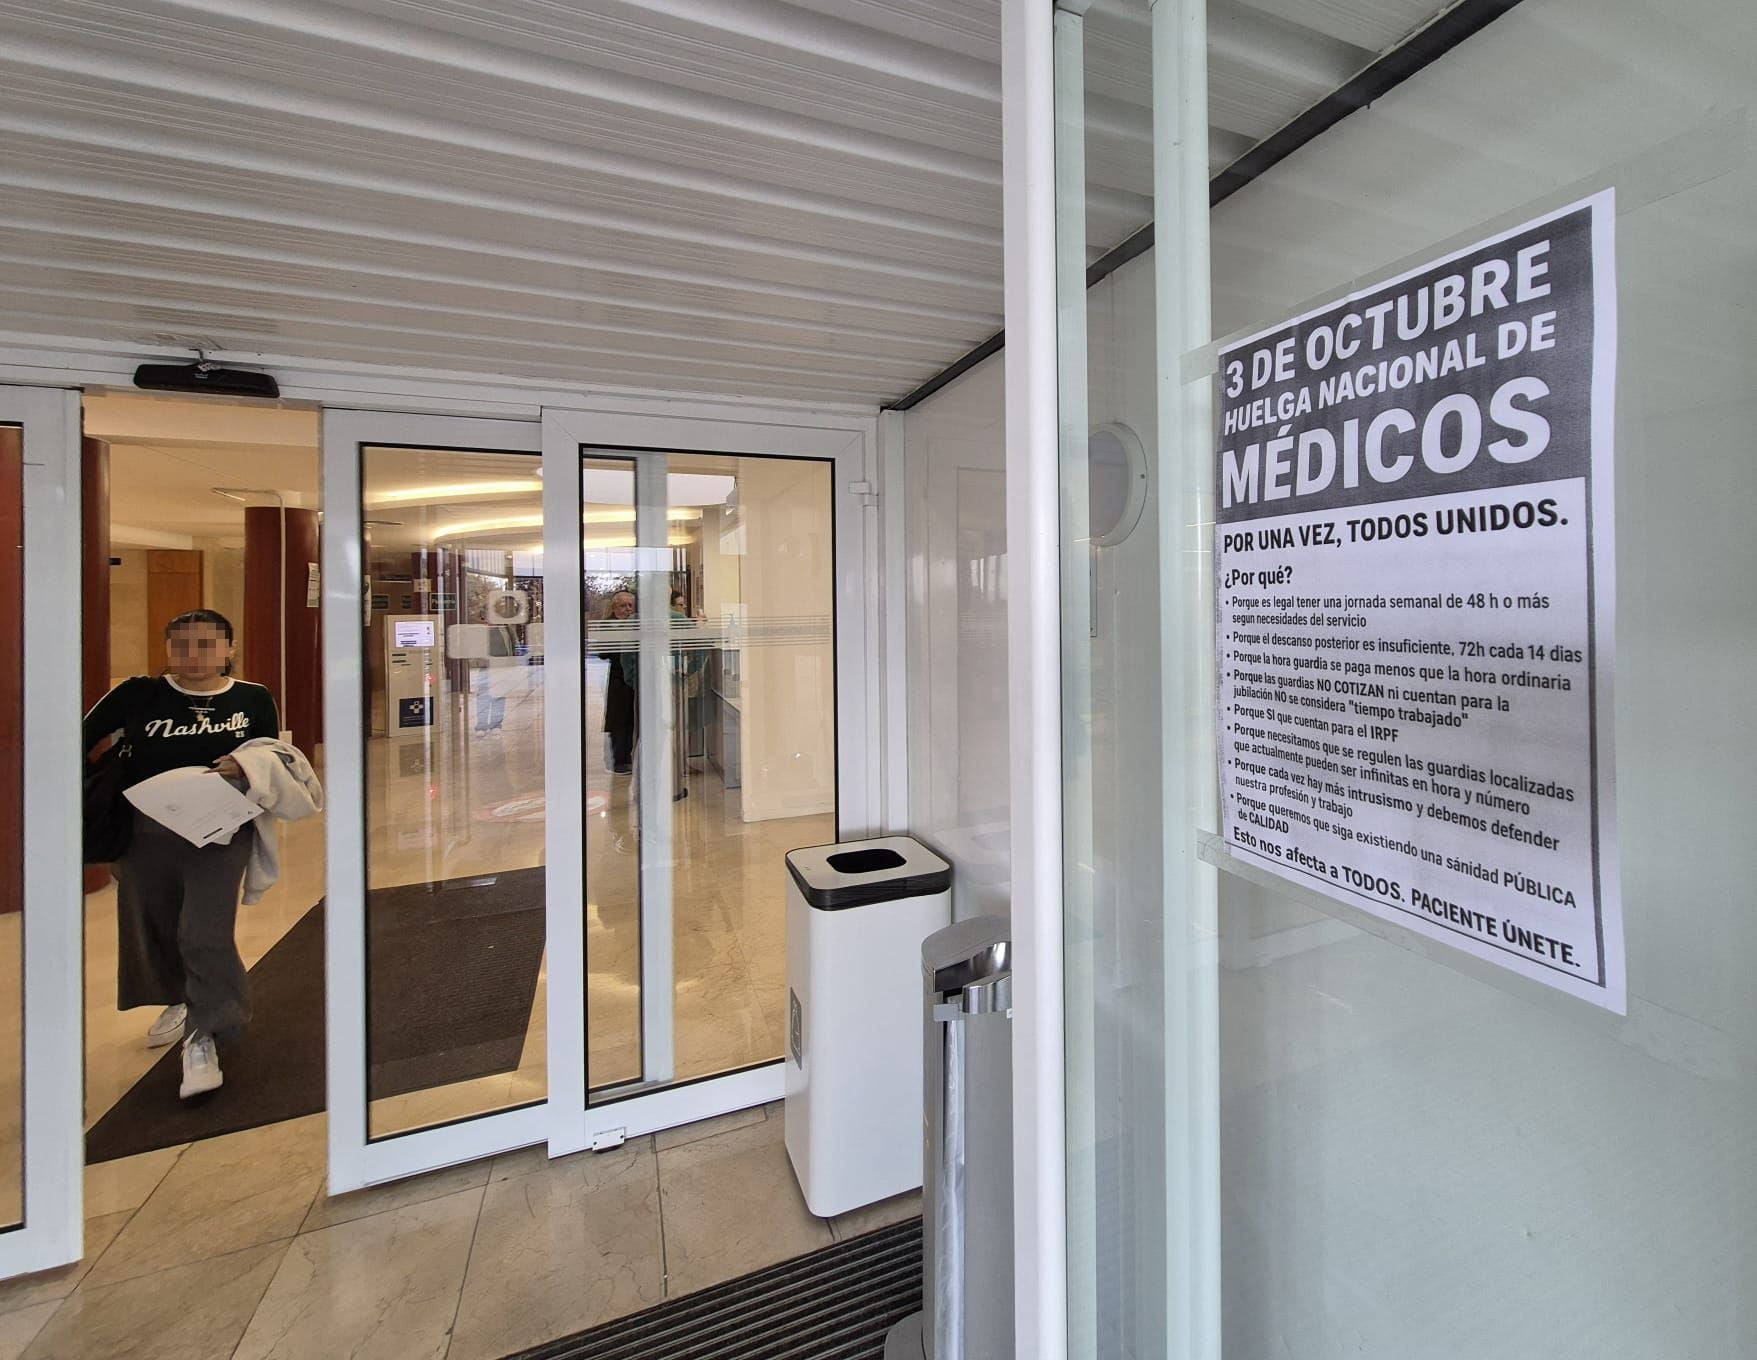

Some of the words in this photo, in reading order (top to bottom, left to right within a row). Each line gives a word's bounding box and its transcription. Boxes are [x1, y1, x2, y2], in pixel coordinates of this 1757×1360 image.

[1226, 360, 1243, 398] 3
[1251, 337, 1295, 390] DE
[1305, 239, 1552, 371] OCTUBRE
[1225, 387, 1311, 436] HUELGA
[1318, 332, 1485, 409] NACIONAL
[1498, 311, 1557, 360] DE
[1222, 376, 1551, 509] MÉDICOS
[1224, 532, 1254, 553] POR
[1258, 527, 1295, 550] UNA
[1298, 522, 1342, 548] VEZ,
[1346, 512, 1428, 542] TODOS
[1436, 498, 1568, 535] UNIDOS.
[1224, 568, 1255, 589] ¿Por
[1258, 565, 1293, 589] qué?
[1232, 596, 1259, 610] Porque
[1261, 598, 1271, 607] es
[1273, 595, 1294, 610] legal
[1296, 596, 1321, 608] tener
[1323, 597, 1342, 608] una
[1344, 594, 1386, 611] jornada
[1390, 593, 1442, 608] semanal
[1446, 593, 1463, 608] de
[1467, 593, 1485, 608] 48
[1489, 593, 1499, 608] h
[1503, 596, 1512, 608] o
[1517, 592, 1550, 608] más
[1232, 613, 1255, 626] segun
[1256, 612, 1308, 626] necesidades
[1310, 612, 1324, 626] del
[1326, 614, 1367, 628] servicio
[1233, 631, 1261, 647] Porque
[1262, 632, 1269, 644] el
[1271, 633, 1313, 647] descanso
[1315, 634, 1359, 650] posterior
[1362, 639, 1375, 651] es
[1458, 642, 1485, 657] 72h
[1489, 643, 1524, 660] cada
[1528, 645, 1545, 660] 14
[1550, 645, 1582, 663] dias
[1234, 650, 1262, 665] Porque
[1263, 652, 1271, 664] la
[1272, 653, 1291, 667] hora
[1293, 656, 1328, 671] guardia
[1330, 660, 1342, 671] se
[1344, 662, 1371, 676] paga
[1374, 663, 1415, 677] menos
[1419, 667, 1444, 681] que
[1448, 666, 1459, 681] la
[1464, 667, 1496, 684] hora
[1501, 670, 1571, 691] ordinaria
[1234, 669, 1263, 685] Porque
[1264, 670, 1276, 684] las
[1278, 673, 1314, 690] guardias
[1317, 678, 1331, 692] NO
[1334, 680, 1384, 698] COTIZAN
[1388, 686, 1399, 700] ni
[1403, 690, 1456, 706] cuentan
[1461, 696, 1492, 710] para
[1498, 695, 1509, 712] la
[145, 711, 250, 738] Nashville
[1233, 685, 1273, 700] jubilación
[1274, 689, 1287, 703] NO
[1289, 694, 1299, 704] se
[1300, 697, 1346, 713] considera
[1348, 700, 1395, 721] "tiempo
[1397, 707, 1468, 727] trabajado"
[1234, 704, 1265, 719] Porque
[1277, 712, 1292, 724] que
[1294, 715, 1329, 732] cuentan
[1331, 721, 1354, 736] para
[1357, 724, 1368, 737] el
[1370, 725, 1399, 742] IRPF
[1234, 723, 1265, 740] Porque
[1267, 730, 1320, 751] necesitamos
[1322, 742, 1340, 757] que
[1342, 746, 1354, 758] se
[1357, 749, 1402, 766] regulen
[1405, 754, 1424, 771] las
[1427, 761, 1486, 783] guardias
[1490, 769, 1574, 802] localizadas
[1234, 740, 1250, 753] que
[1251, 743, 1303, 764] actualmente
[1305, 754, 1338, 773] pueden
[1340, 763, 1356, 778] ser
[1360, 766, 1409, 787] infinitas
[1412, 777, 1428, 791] en
[1431, 778, 1461, 798] hora
[1464, 788, 1472, 805] y
[1476, 790, 1530, 815] número
[1235, 774, 1267, 792] nuestra
[1269, 782, 1309, 804] profesión
[1310, 797, 1317, 809] y
[1319, 797, 1353, 818] trabajo
[1235, 757, 1266, 775] Porque
[1268, 765, 1289, 780] cada
[1291, 771, 1305, 785] vez
[1307, 774, 1323, 794] hay
[1325, 780, 1345, 796] más
[1347, 787, 1412, 812] intrusismo
[1416, 803, 1424, 818] y
[1427, 803, 1487, 832] debemos
[1491, 820, 1560, 851] defender
[1238, 808, 1248, 821] de
[1249, 811, 1289, 834] CALIDAD
[1236, 792, 1266, 811] Porque
[1268, 801, 1311, 825] queremos
[1313, 817, 1330, 833] que
[1332, 824, 1353, 840] siga
[1356, 832, 1418, 857] existiendo
[1421, 848, 1443, 866] una
[1504, 871, 1577, 909] PÚBLICA
[1234, 826, 1257, 848] Esto
[1259, 839, 1282, 857] nos
[1286, 847, 1326, 874] afecta
[1330, 866, 1338, 880] a
[1341, 866, 1405, 903] TODOS.
[1411, 887, 1498, 938] PACIENTE
[1502, 919, 1581, 967] ÚNETE.
